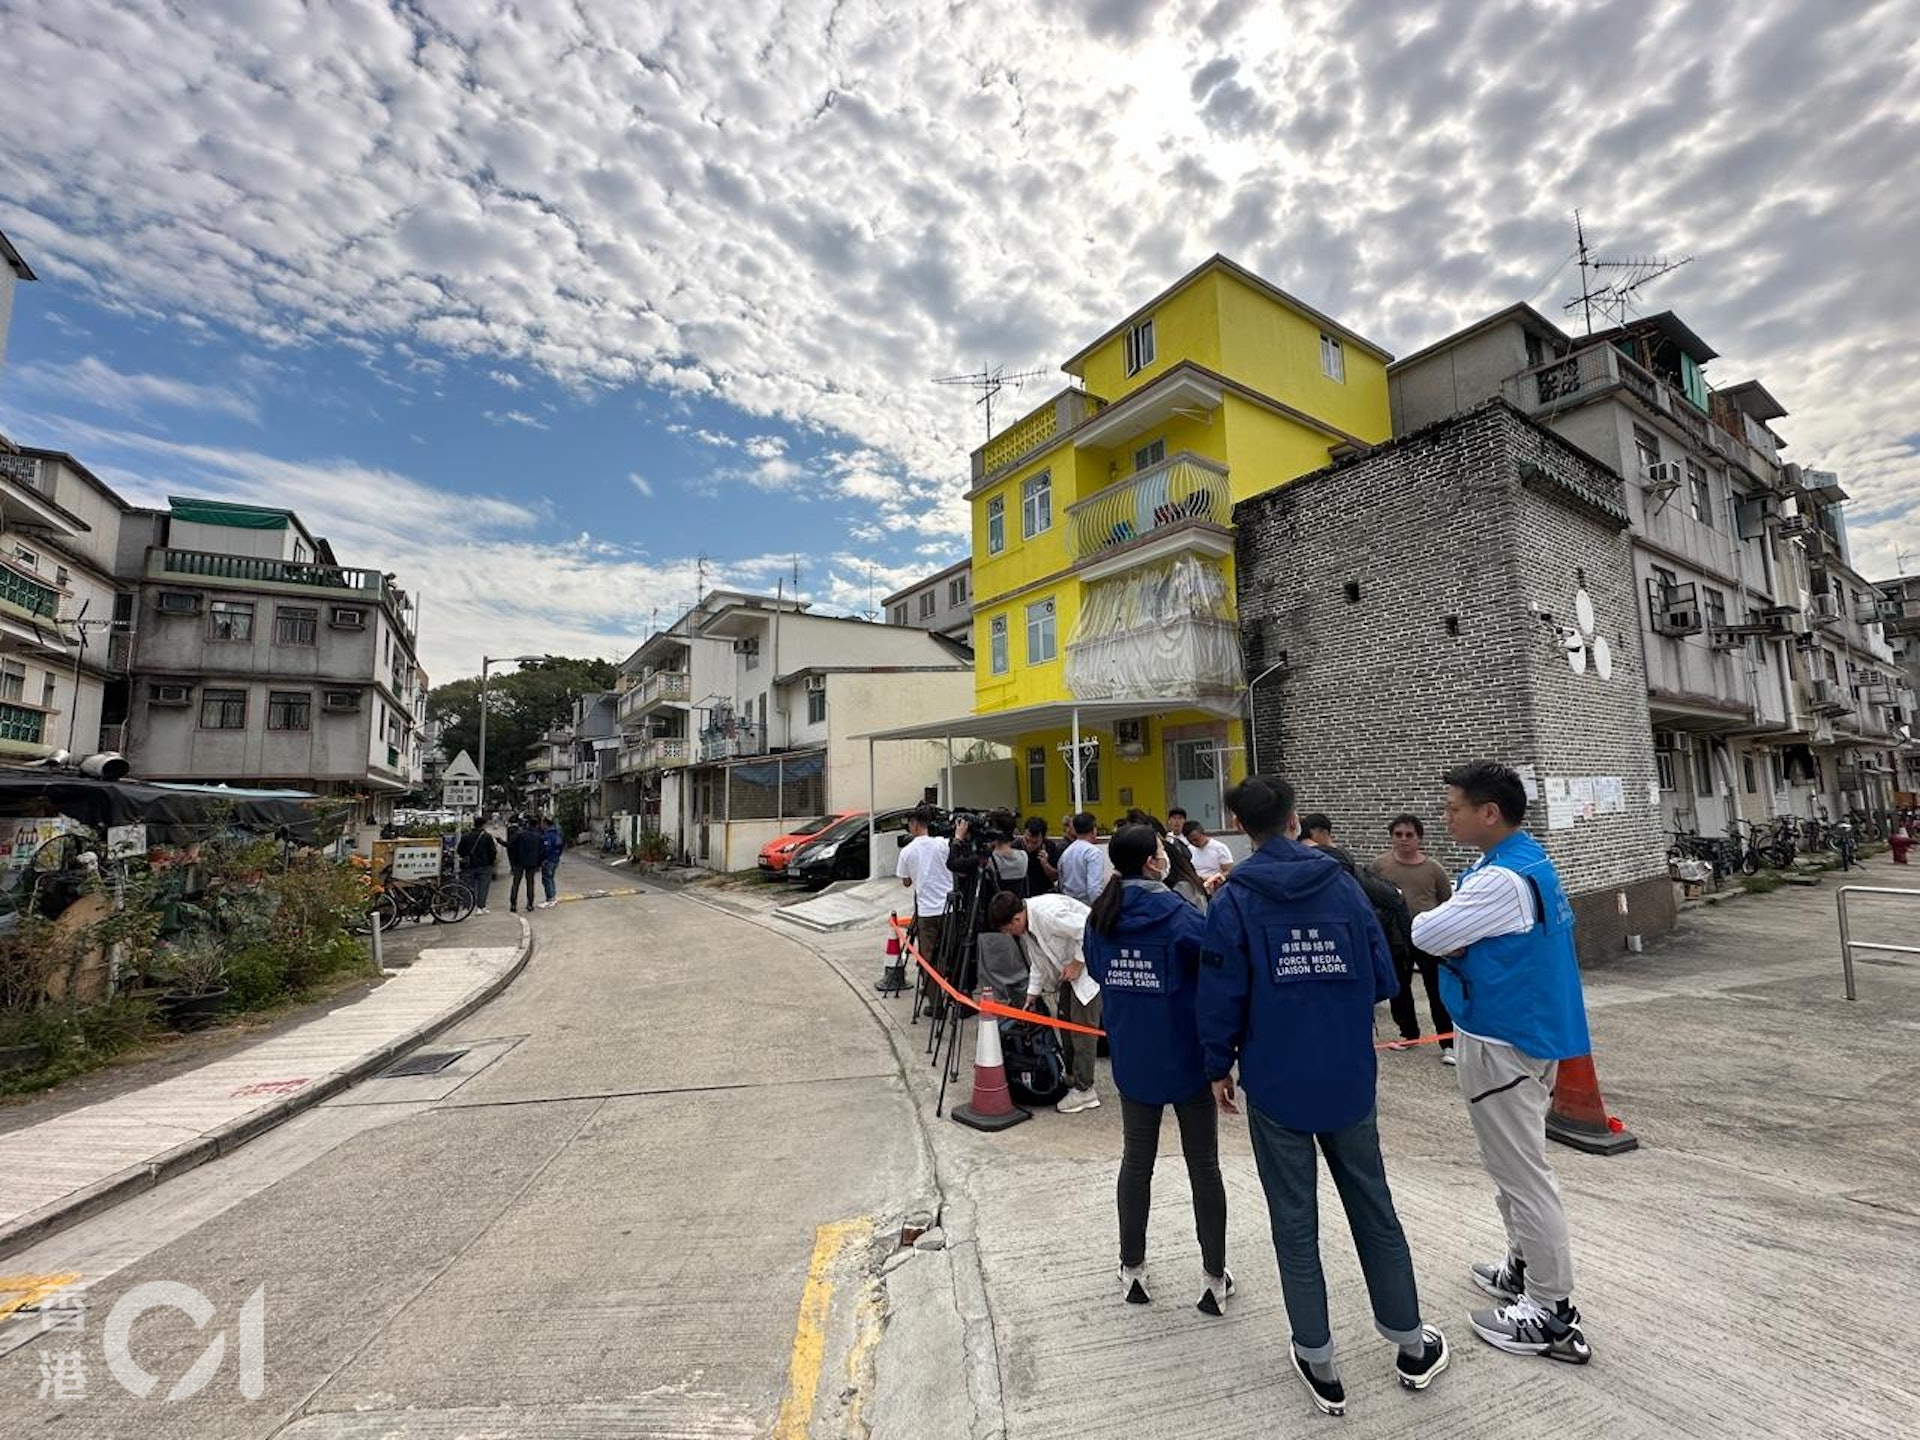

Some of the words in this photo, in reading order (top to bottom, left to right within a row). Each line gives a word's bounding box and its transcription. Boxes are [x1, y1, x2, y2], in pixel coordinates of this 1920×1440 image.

[1278, 955, 1308, 966] FORCE
[1311, 954, 1343, 964] MEDIA
[1107, 969, 1131, 978] FORCE
[1133, 971, 1157, 980] MEDIA
[1275, 964, 1311, 976] LIAISON
[1314, 963, 1348, 973] CADRE
[1104, 977, 1134, 986] LIAISON
[1135, 979, 1161, 988] CADRE
